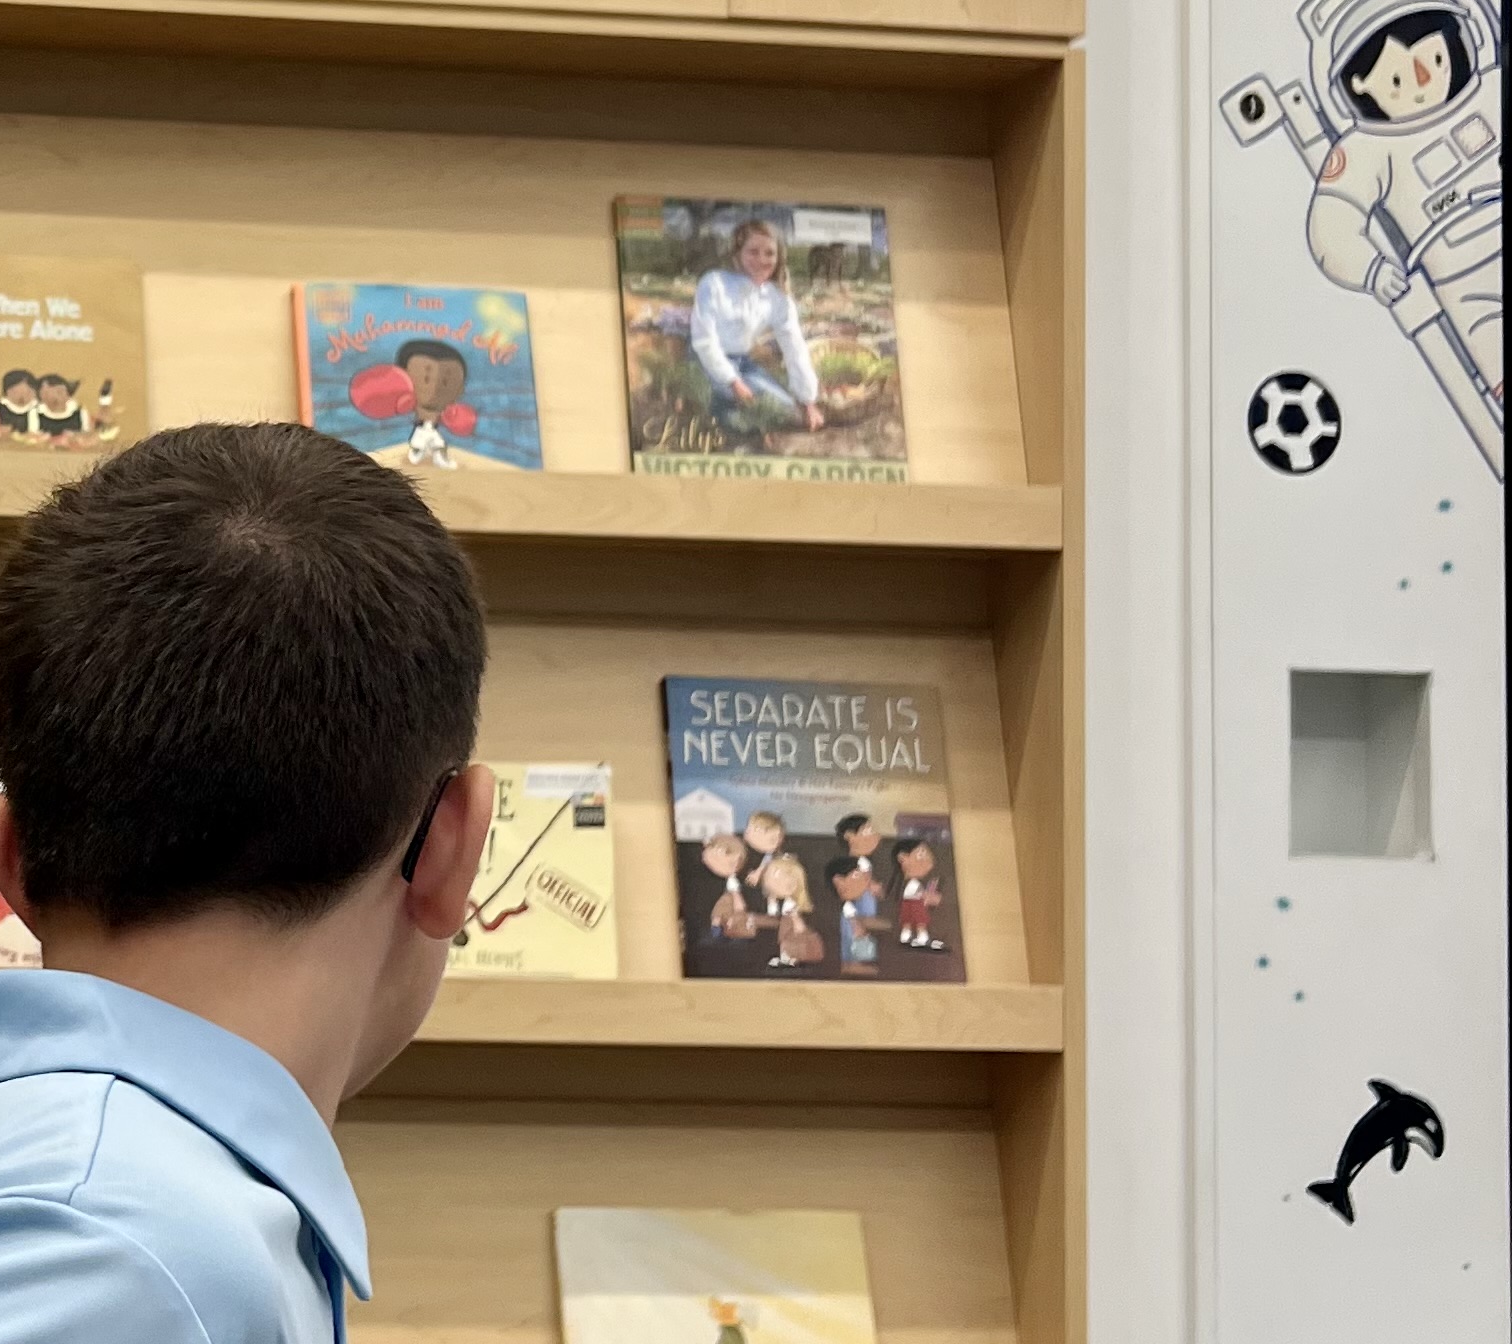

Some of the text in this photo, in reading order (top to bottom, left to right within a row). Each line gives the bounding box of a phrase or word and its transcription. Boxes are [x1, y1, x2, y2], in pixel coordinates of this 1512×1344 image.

[45, 297, 82, 319] We
[29, 320, 95, 343] Alone
[689, 689, 919, 732] SEPARATE IS
[682, 729, 932, 774] NEVER EQUAL
[537, 870, 599, 924] OFFICIAL
